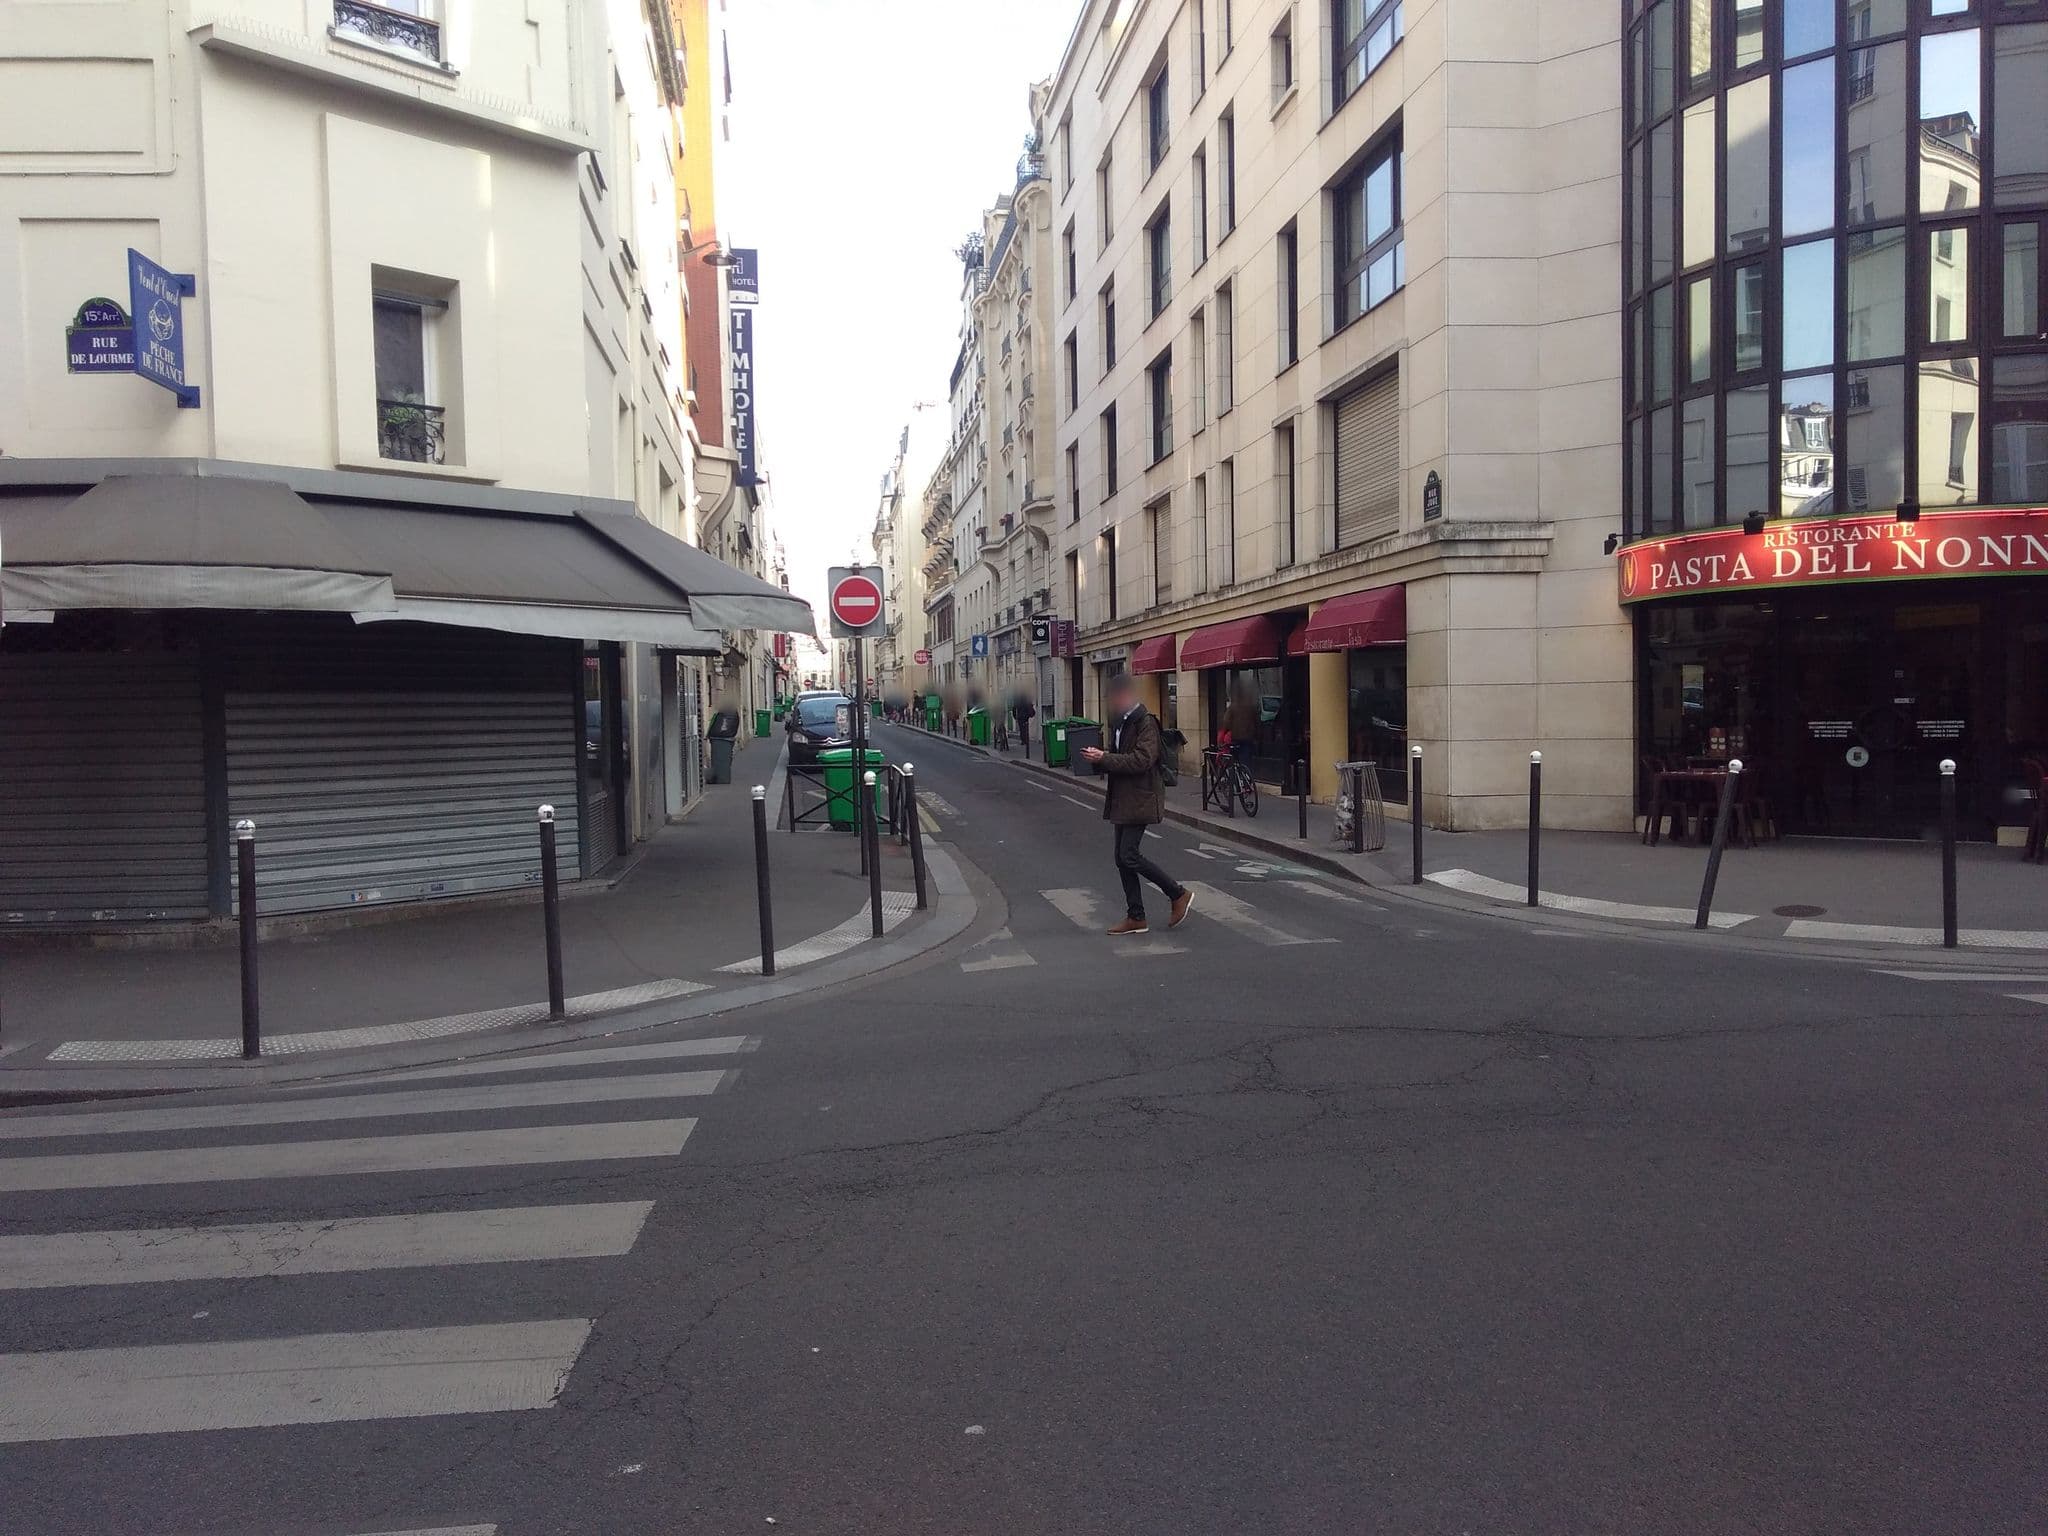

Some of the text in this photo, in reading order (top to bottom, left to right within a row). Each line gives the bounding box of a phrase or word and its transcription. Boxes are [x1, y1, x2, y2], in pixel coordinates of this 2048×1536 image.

[92, 337, 118, 348] RUE
[71, 353, 87, 364] DE
[154, 357, 184, 386] FRANCE
[731, 312, 750, 470] TIMHOTEL
[1764, 522, 1916, 548] RISTORANTE
[1650, 552, 1755, 590] PASTA
[1772, 543, 1872, 578] DEL
